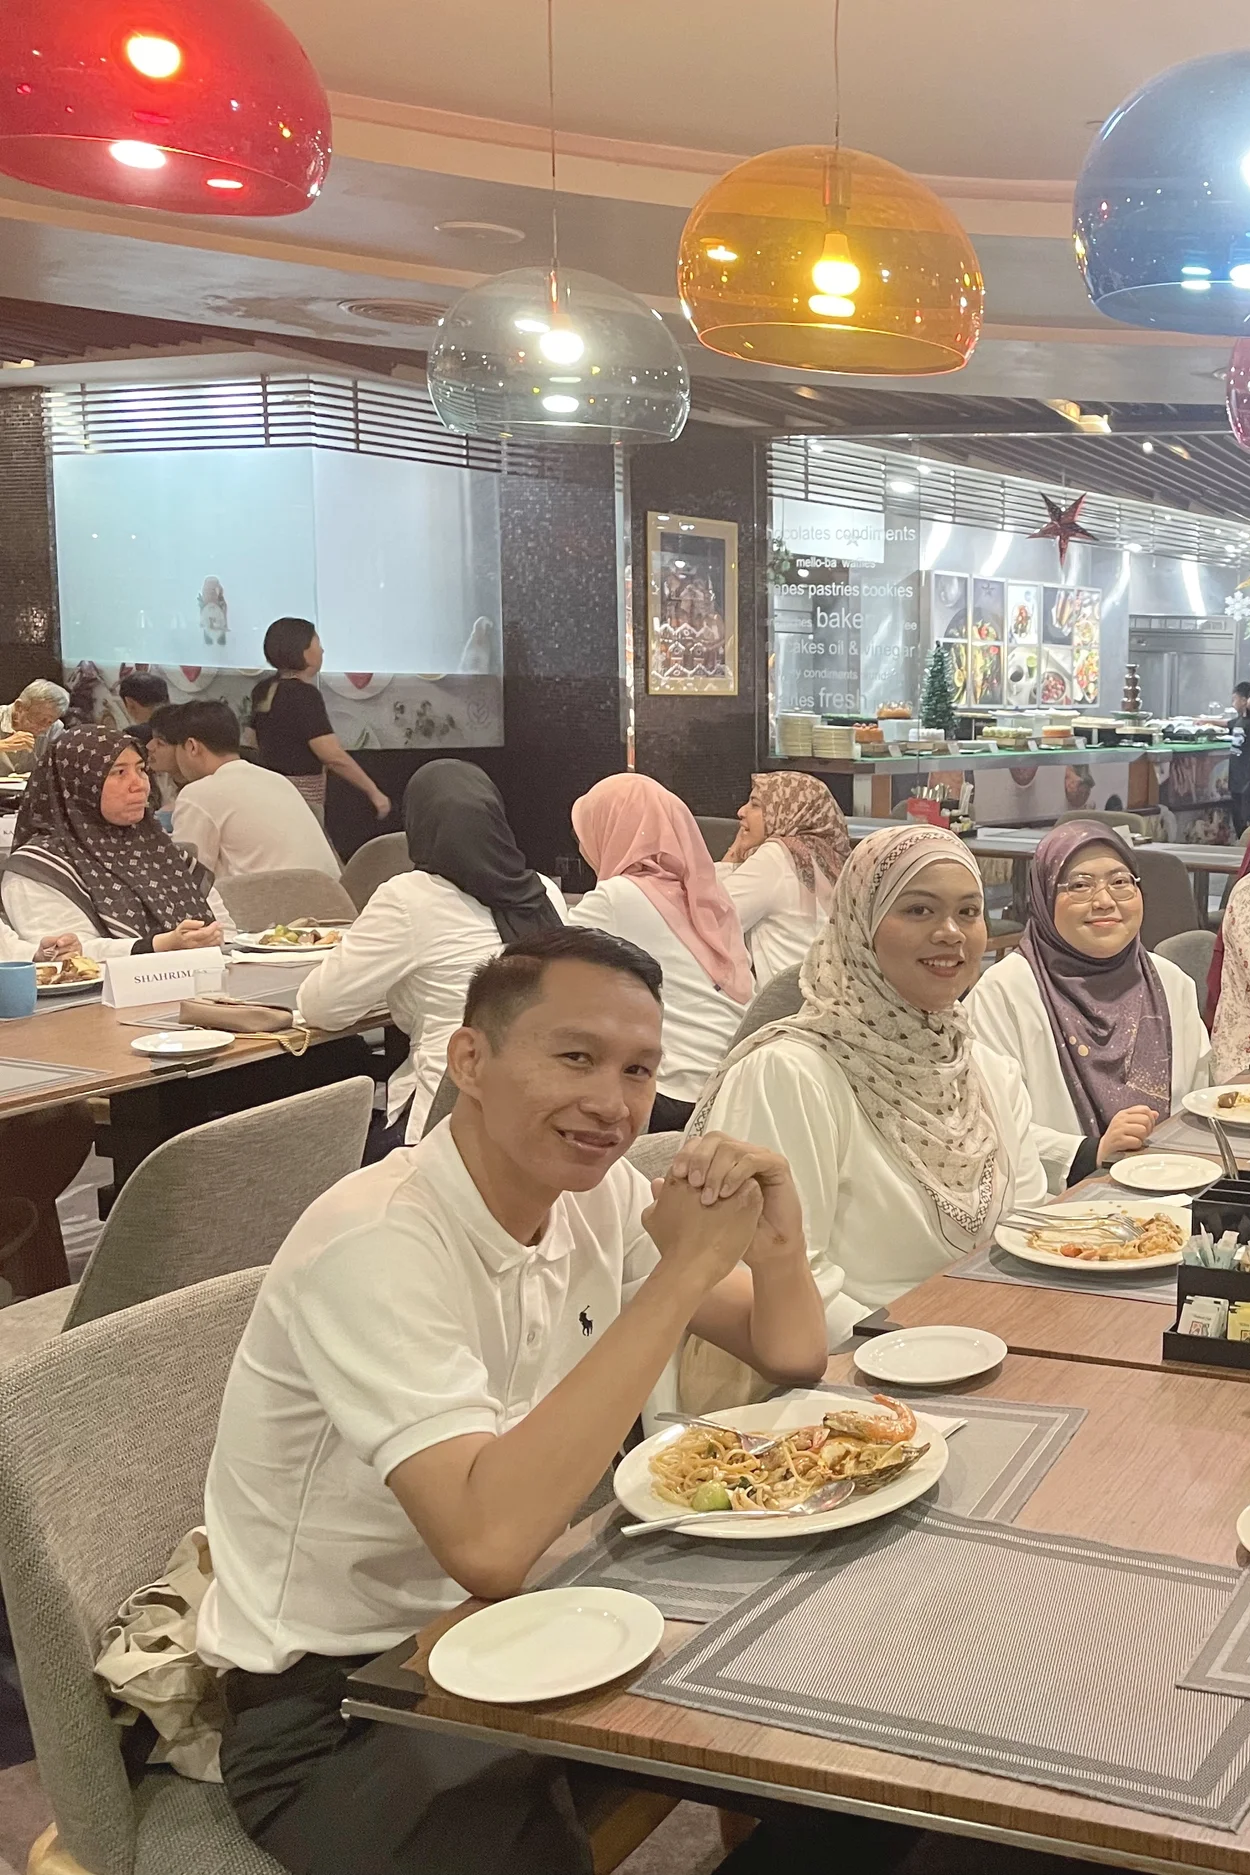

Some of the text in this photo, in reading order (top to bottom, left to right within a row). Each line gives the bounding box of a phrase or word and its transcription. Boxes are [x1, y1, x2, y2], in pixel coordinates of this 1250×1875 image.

[835, 526, 916, 541] condiments
[808, 582, 860, 599] pastries
[862, 583, 914, 598] cookies
[828, 640, 845, 655] oil
[848, 641, 859, 656] &
[864, 644, 916, 662] vinegar
[818, 688, 868, 710] fresh
[133, 969, 208, 984] SHAHRIM
